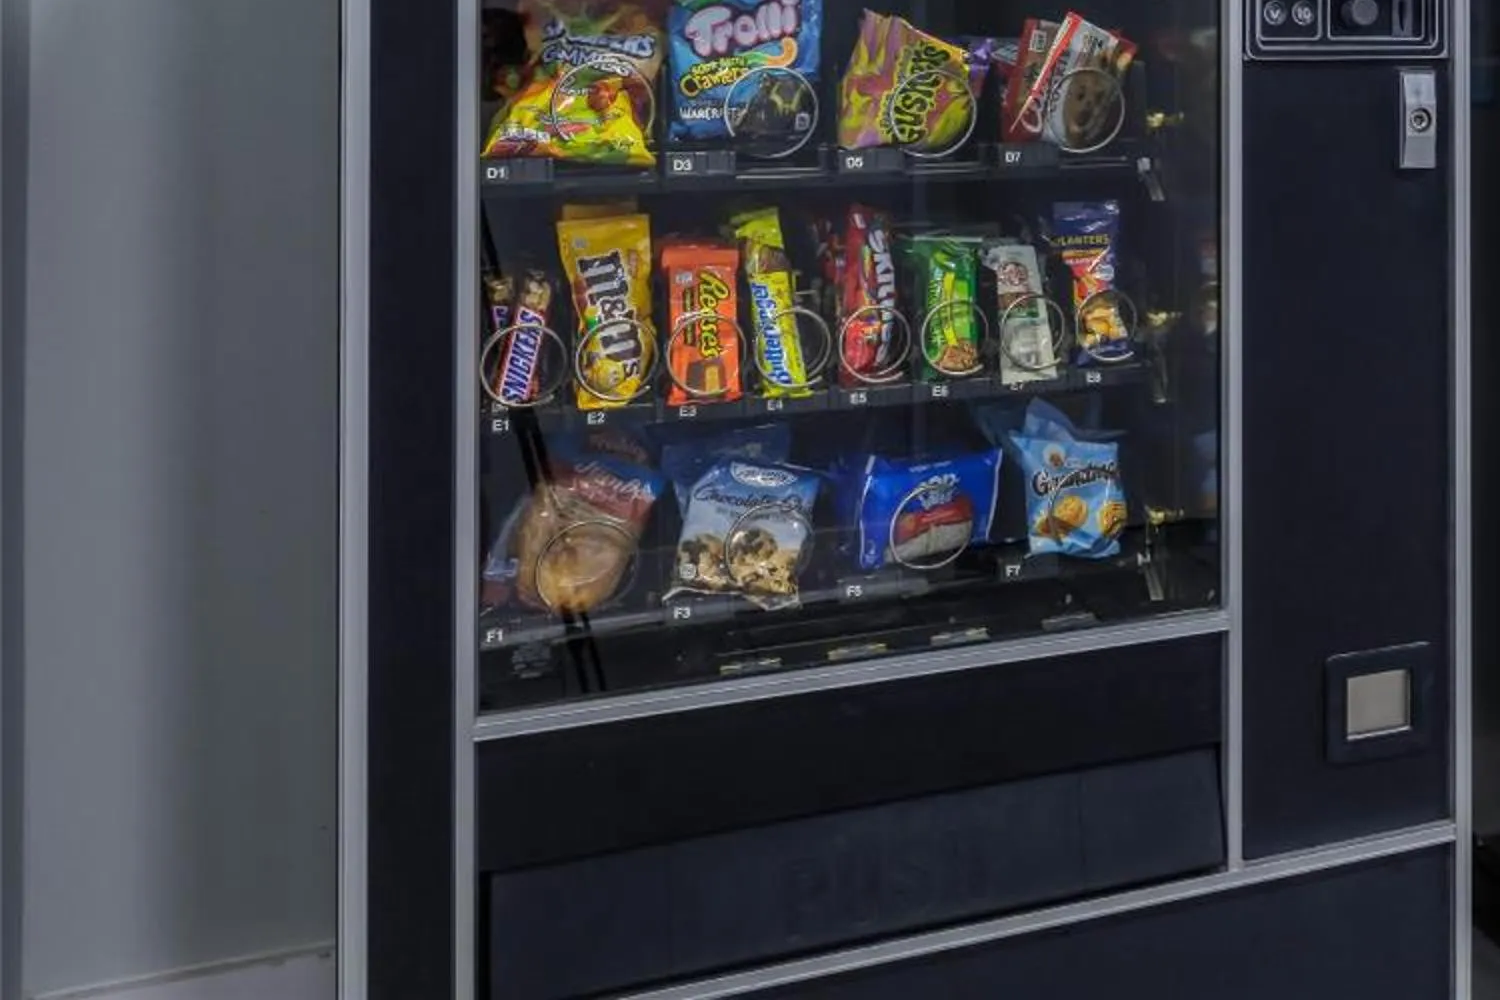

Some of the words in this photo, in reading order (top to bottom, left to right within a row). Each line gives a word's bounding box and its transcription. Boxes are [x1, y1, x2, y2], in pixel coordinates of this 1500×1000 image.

[1298, 7, 1311, 20] 10
[846, 156, 864, 169] D5
[1005, 151, 1022, 163] D7
[673, 159, 693, 171] D3
[487, 167, 506, 180] D1
[501, 307, 542, 401] SNICKERS
[932, 386, 948, 397] E6
[850, 393, 867, 404] E5
[679, 405, 697, 417] E3
[767, 400, 783, 410] E4
[587, 413, 606, 424] E2
[492, 419, 510, 431] E1
[1006, 565, 1021, 577] F7
[674, 607, 691, 619] F3
[486, 631, 503, 643] F1
